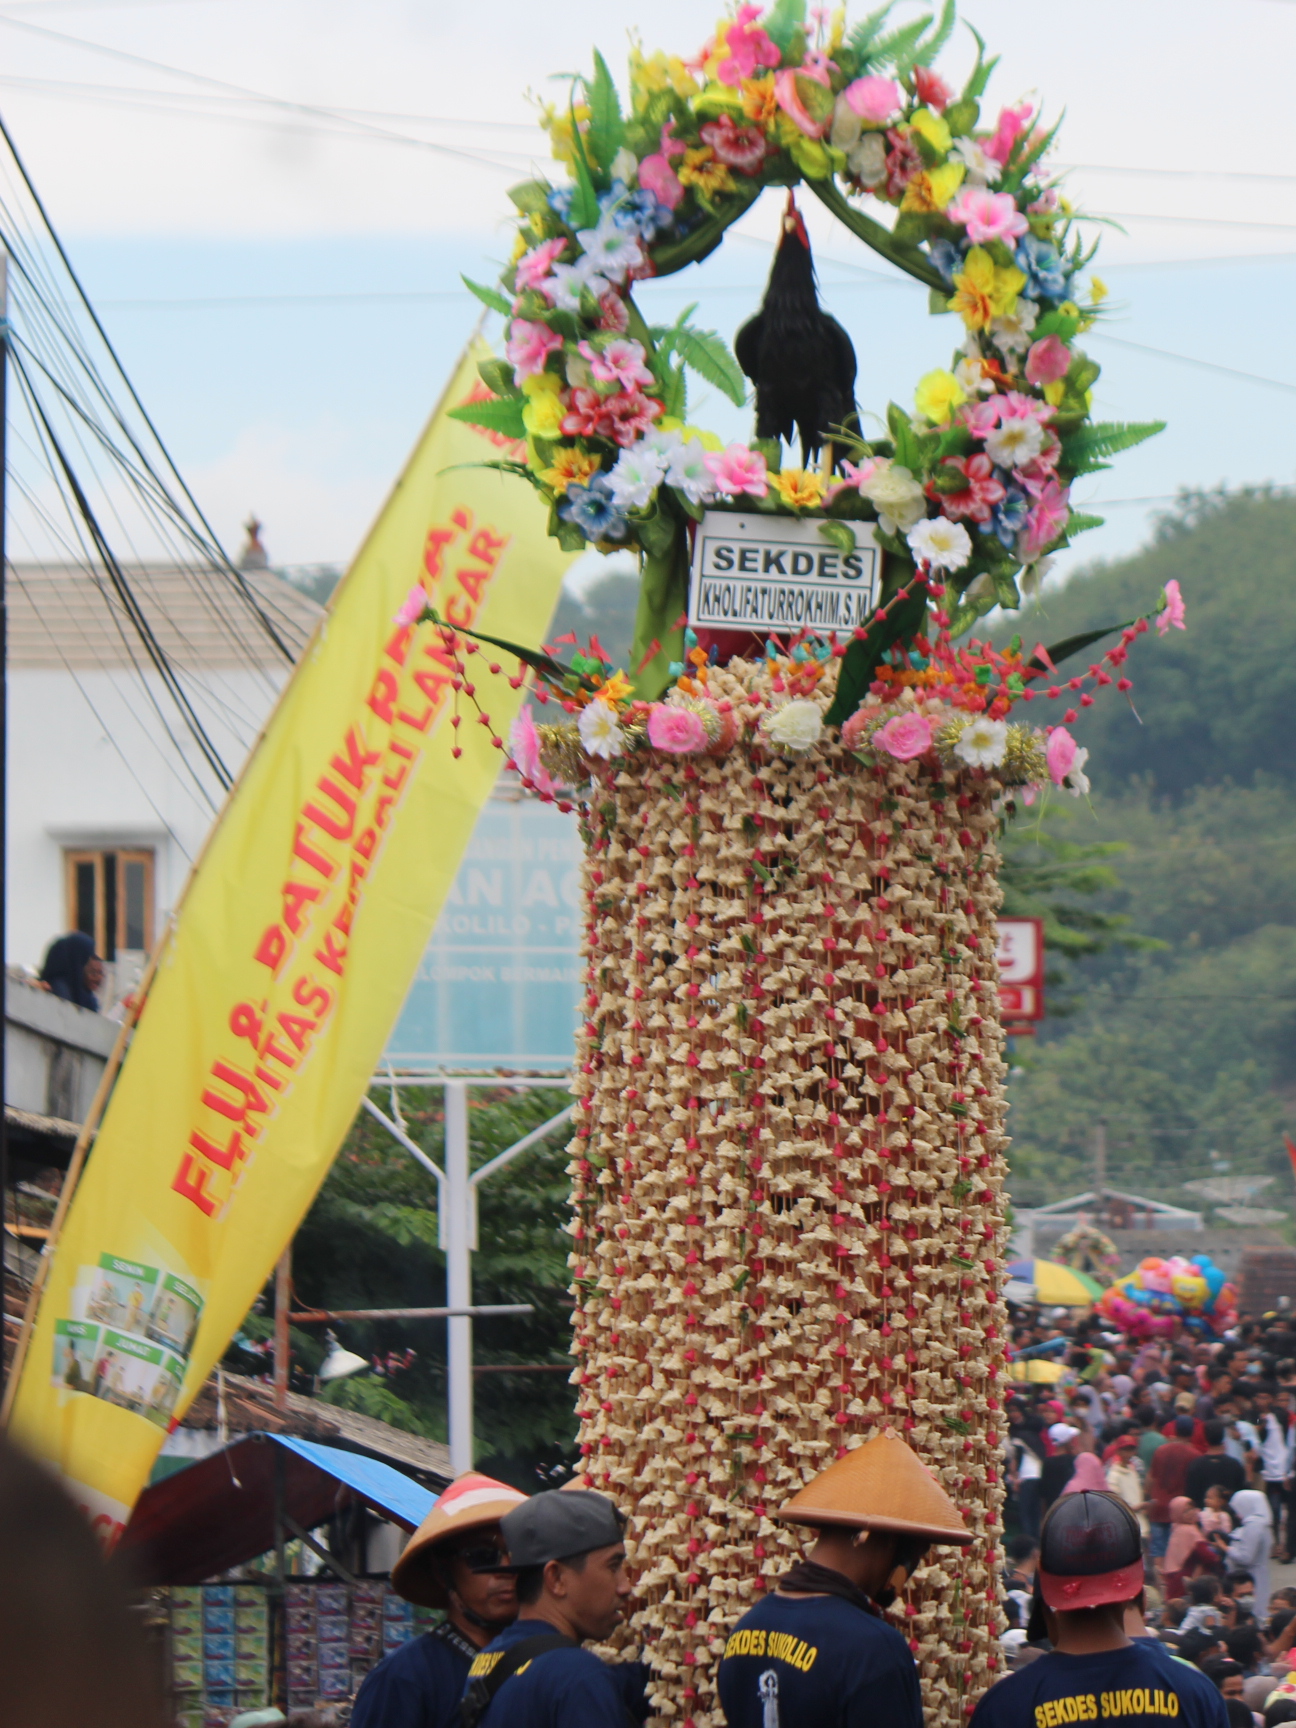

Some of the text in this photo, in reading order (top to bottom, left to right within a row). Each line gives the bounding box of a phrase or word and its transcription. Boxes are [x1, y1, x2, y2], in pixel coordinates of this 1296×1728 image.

[712, 545, 864, 580] SEKDES
[171, 1059, 253, 1217] FLU
[766, 1630, 818, 1673] SUKOLILO
[1034, 1687, 1179, 1728] SEKDES SUKOLILO
